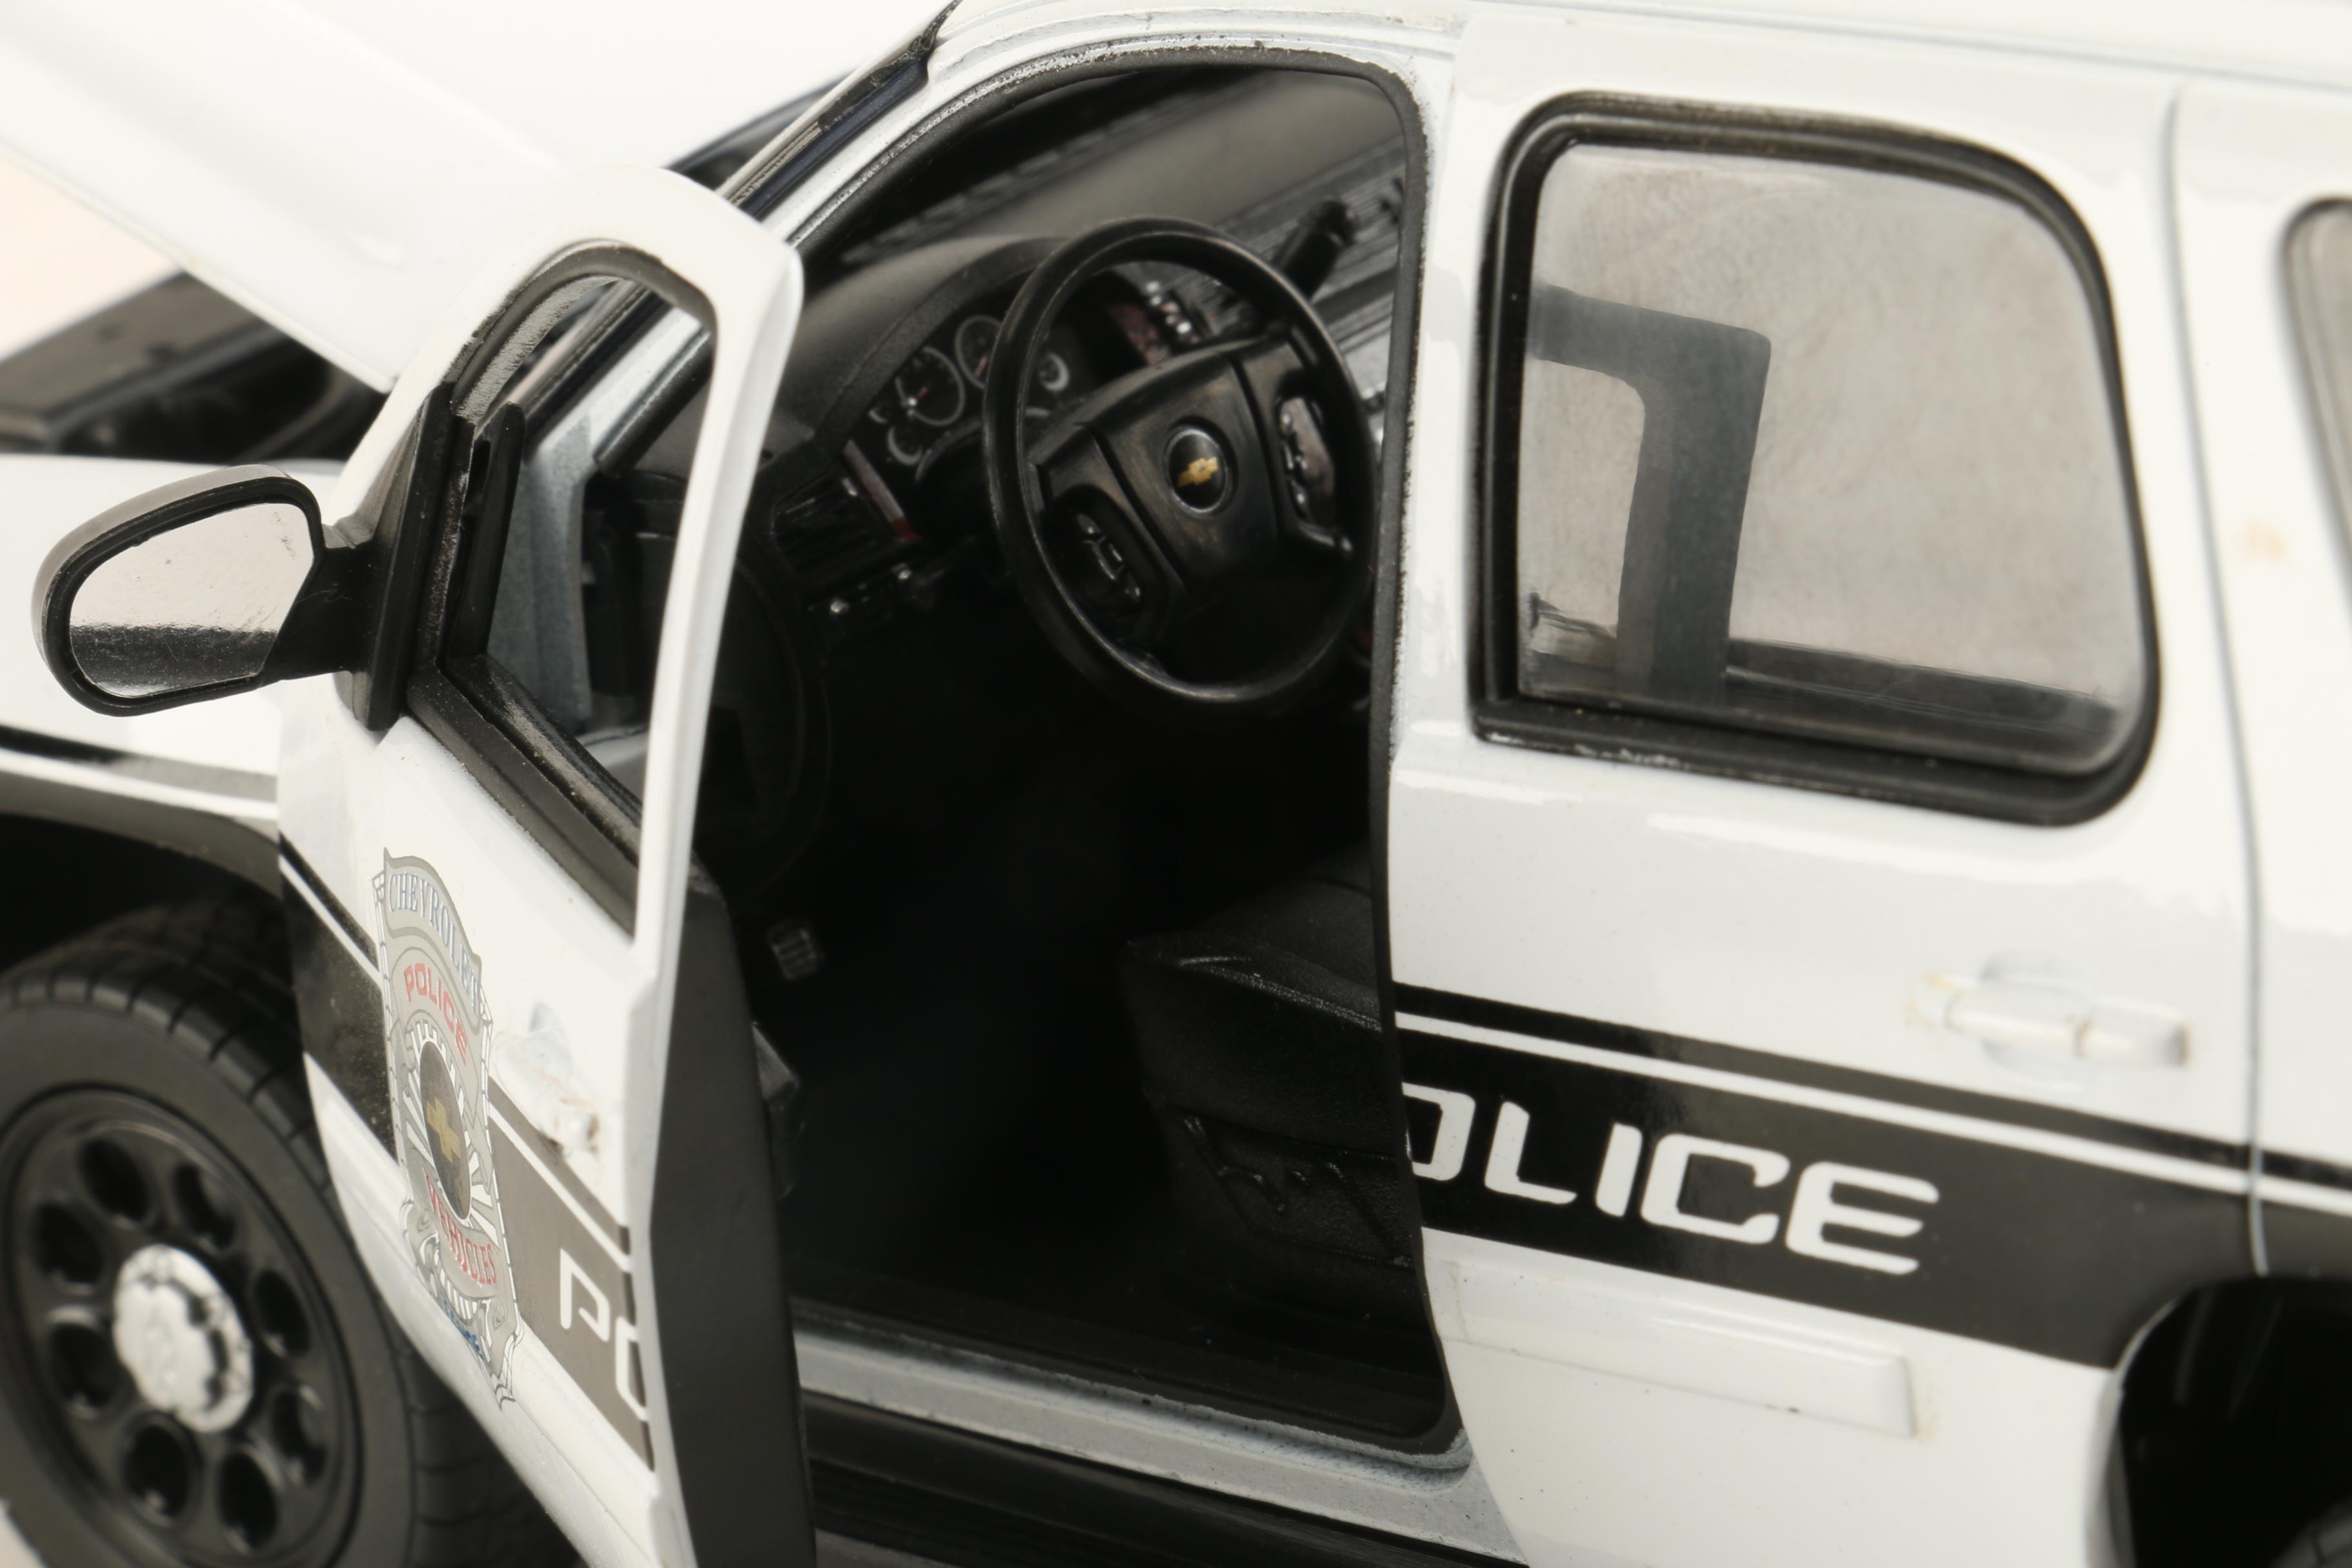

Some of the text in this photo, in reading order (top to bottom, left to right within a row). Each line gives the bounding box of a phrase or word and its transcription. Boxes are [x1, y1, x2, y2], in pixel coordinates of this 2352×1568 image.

[389, 872, 479, 1017] CHEVROLET
[404, 963, 467, 1066] POLICE
[422, 1166, 496, 1285] VEHICLES
